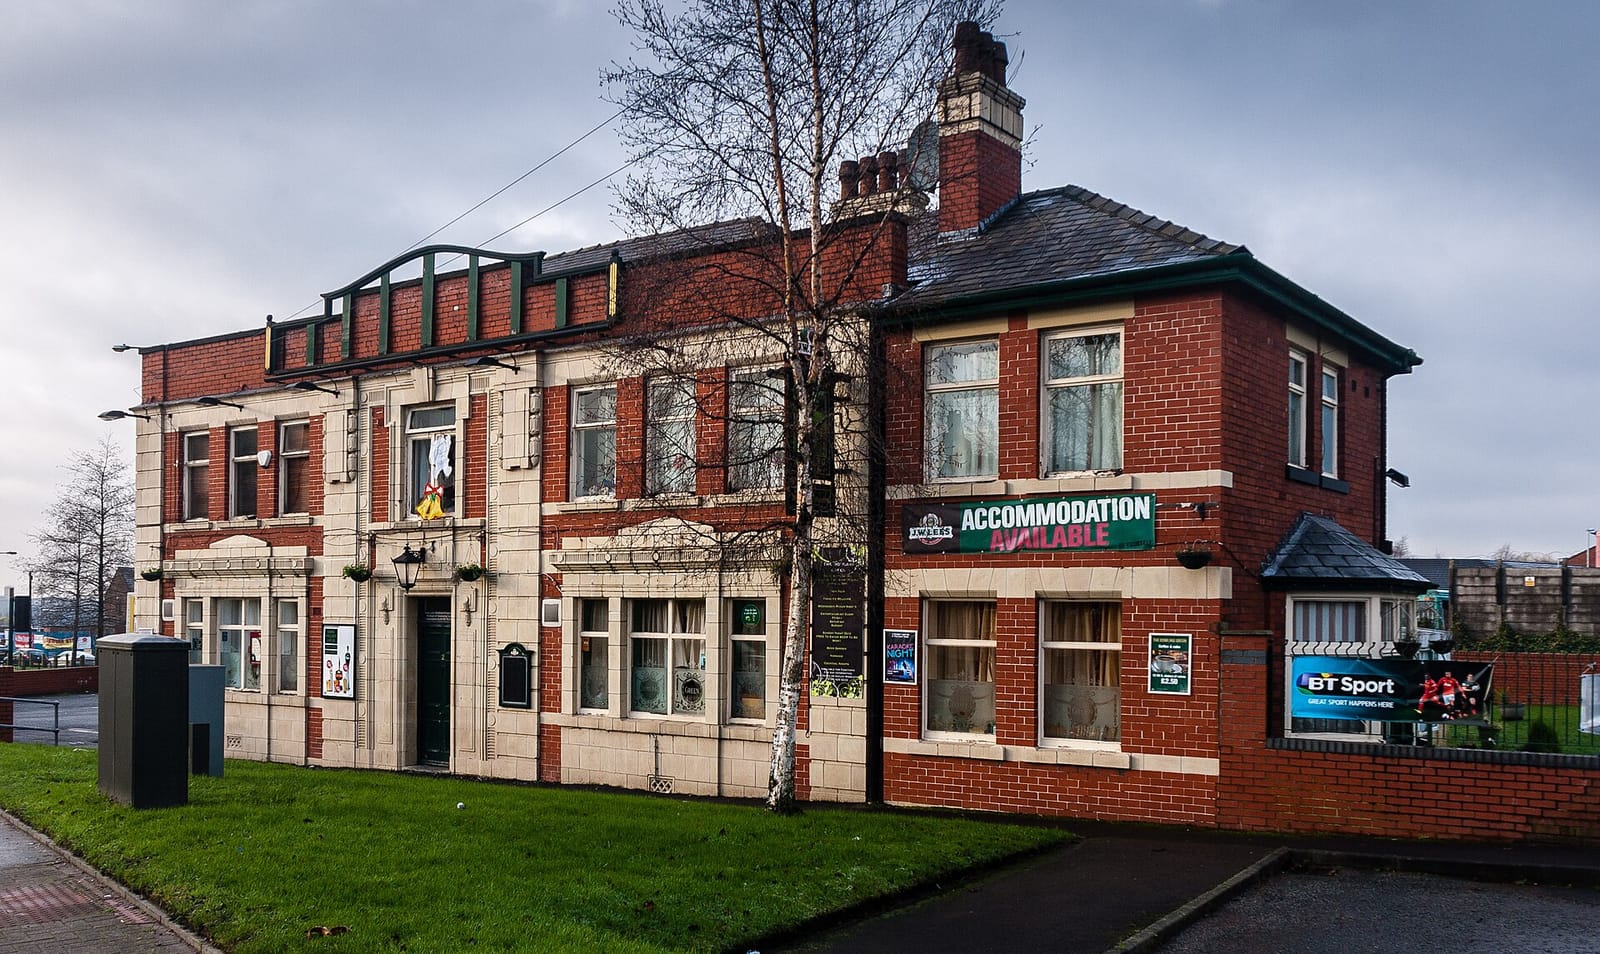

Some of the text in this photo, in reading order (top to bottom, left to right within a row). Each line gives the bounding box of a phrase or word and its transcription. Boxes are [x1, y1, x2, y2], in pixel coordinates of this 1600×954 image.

[961, 495, 1150, 531] ACCOMMODATION
[989, 522, 1110, 552] AVAILABLE
[886, 649, 914, 658] NIGHT
[1308, 676, 1395, 695] BT Sport
[1348, 700, 1377, 708] HAPPENS
[1377, 701, 1395, 709] HERE
